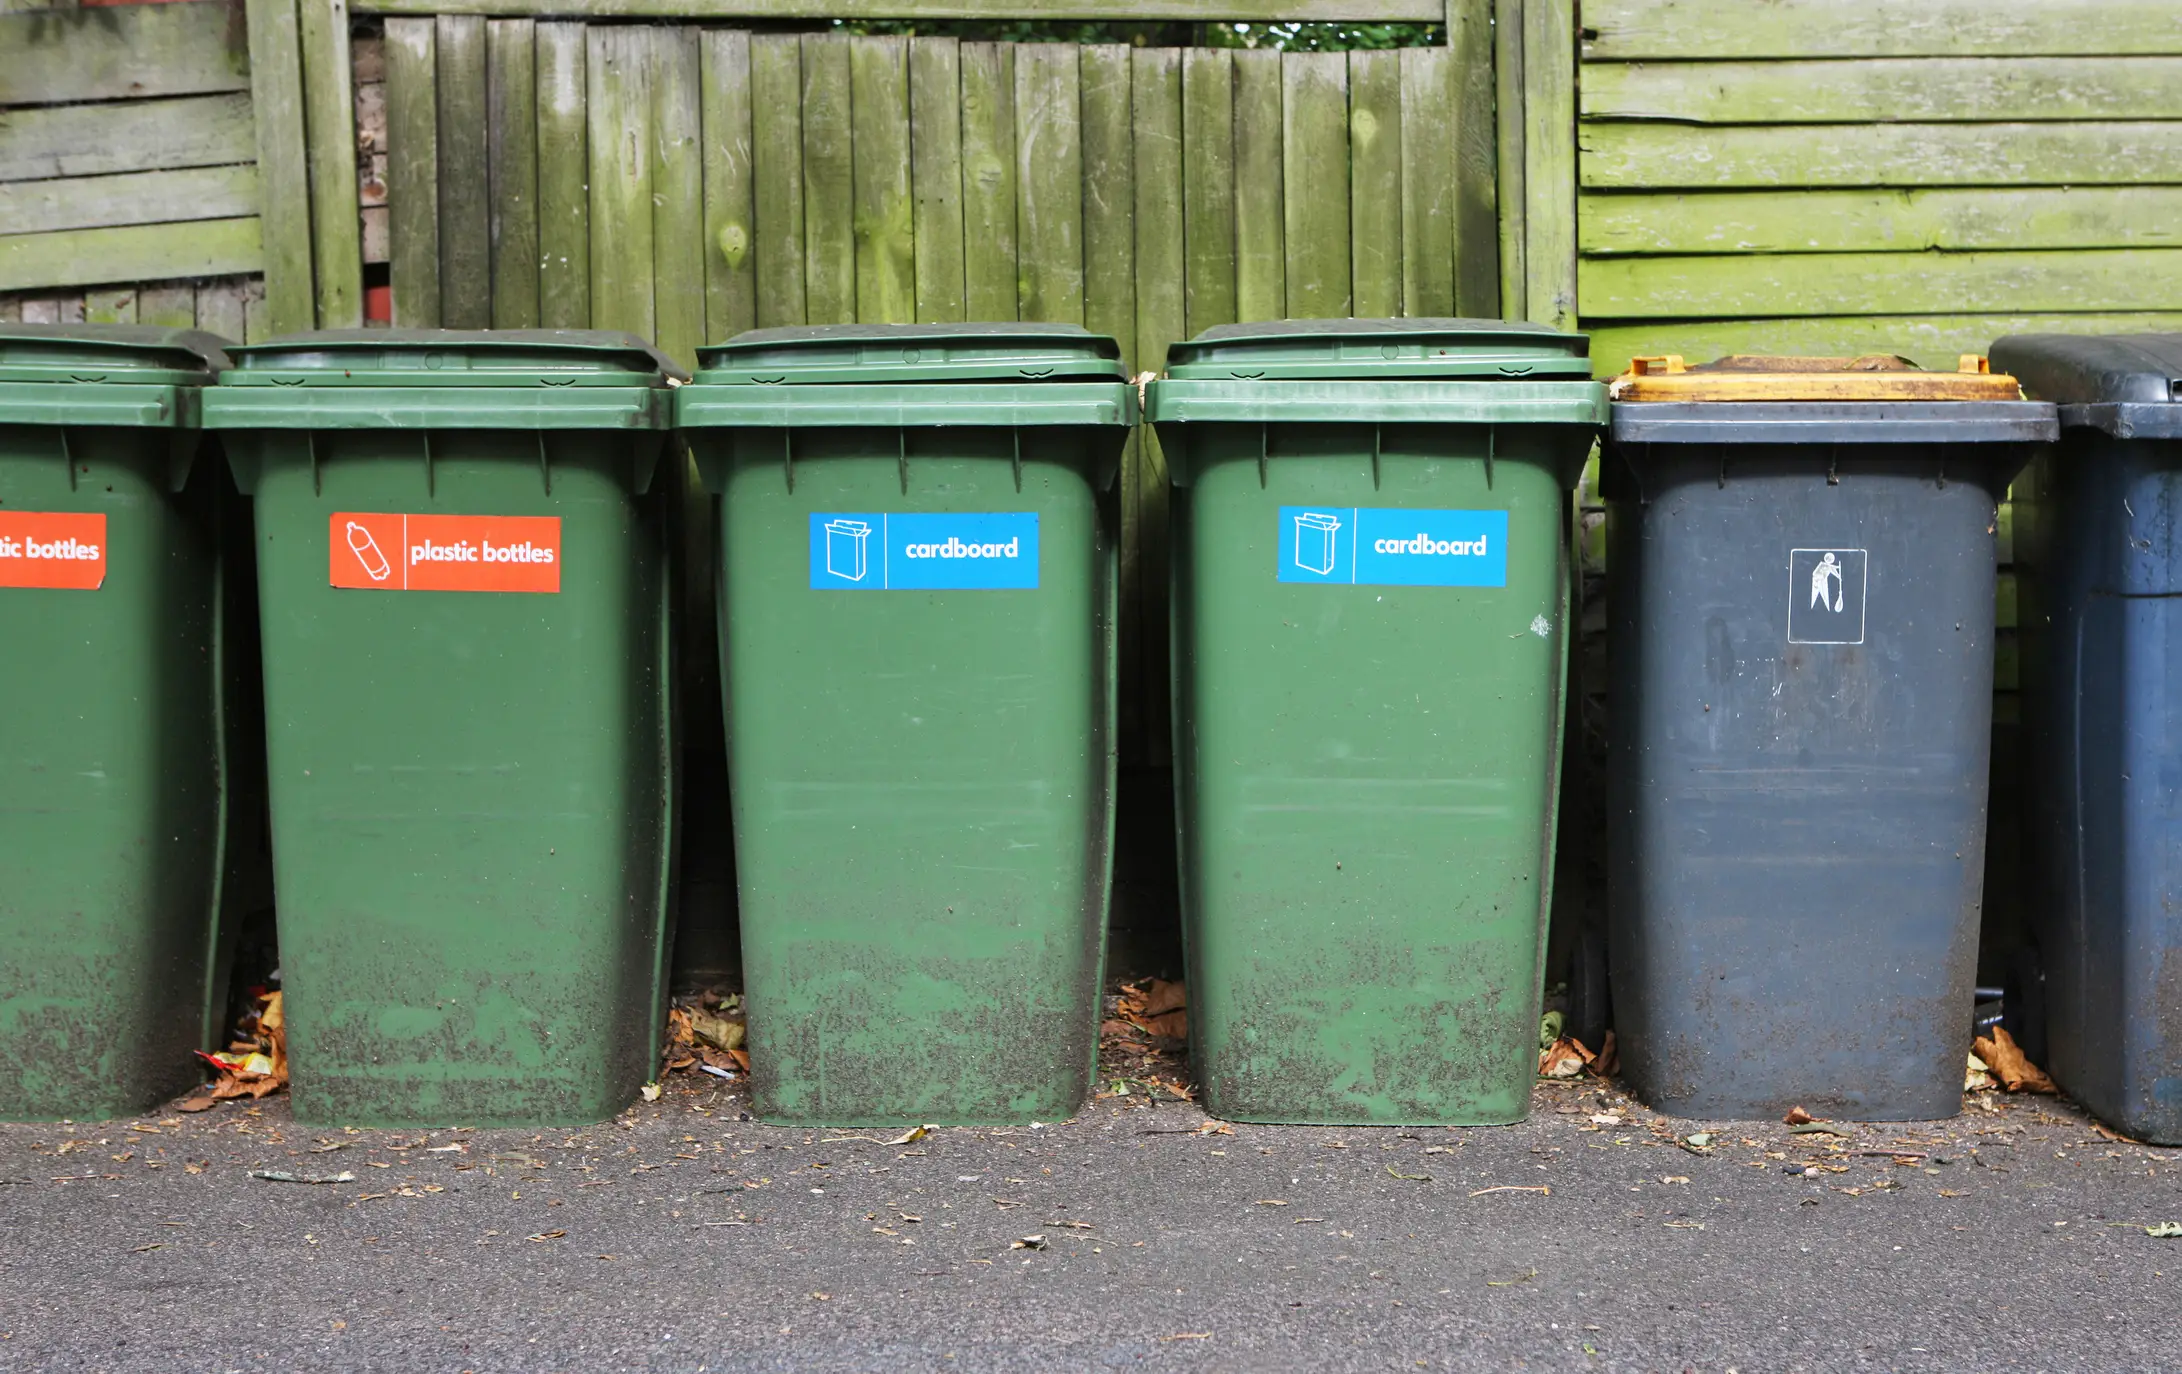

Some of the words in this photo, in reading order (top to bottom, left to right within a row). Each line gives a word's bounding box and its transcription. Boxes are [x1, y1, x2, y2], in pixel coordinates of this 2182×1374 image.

[25, 536, 100, 561] bottles
[410, 539, 479, 566] plastic
[482, 540, 555, 565] bottles
[904, 536, 1020, 560] cardboard
[1373, 532, 1488, 557] cardboard
